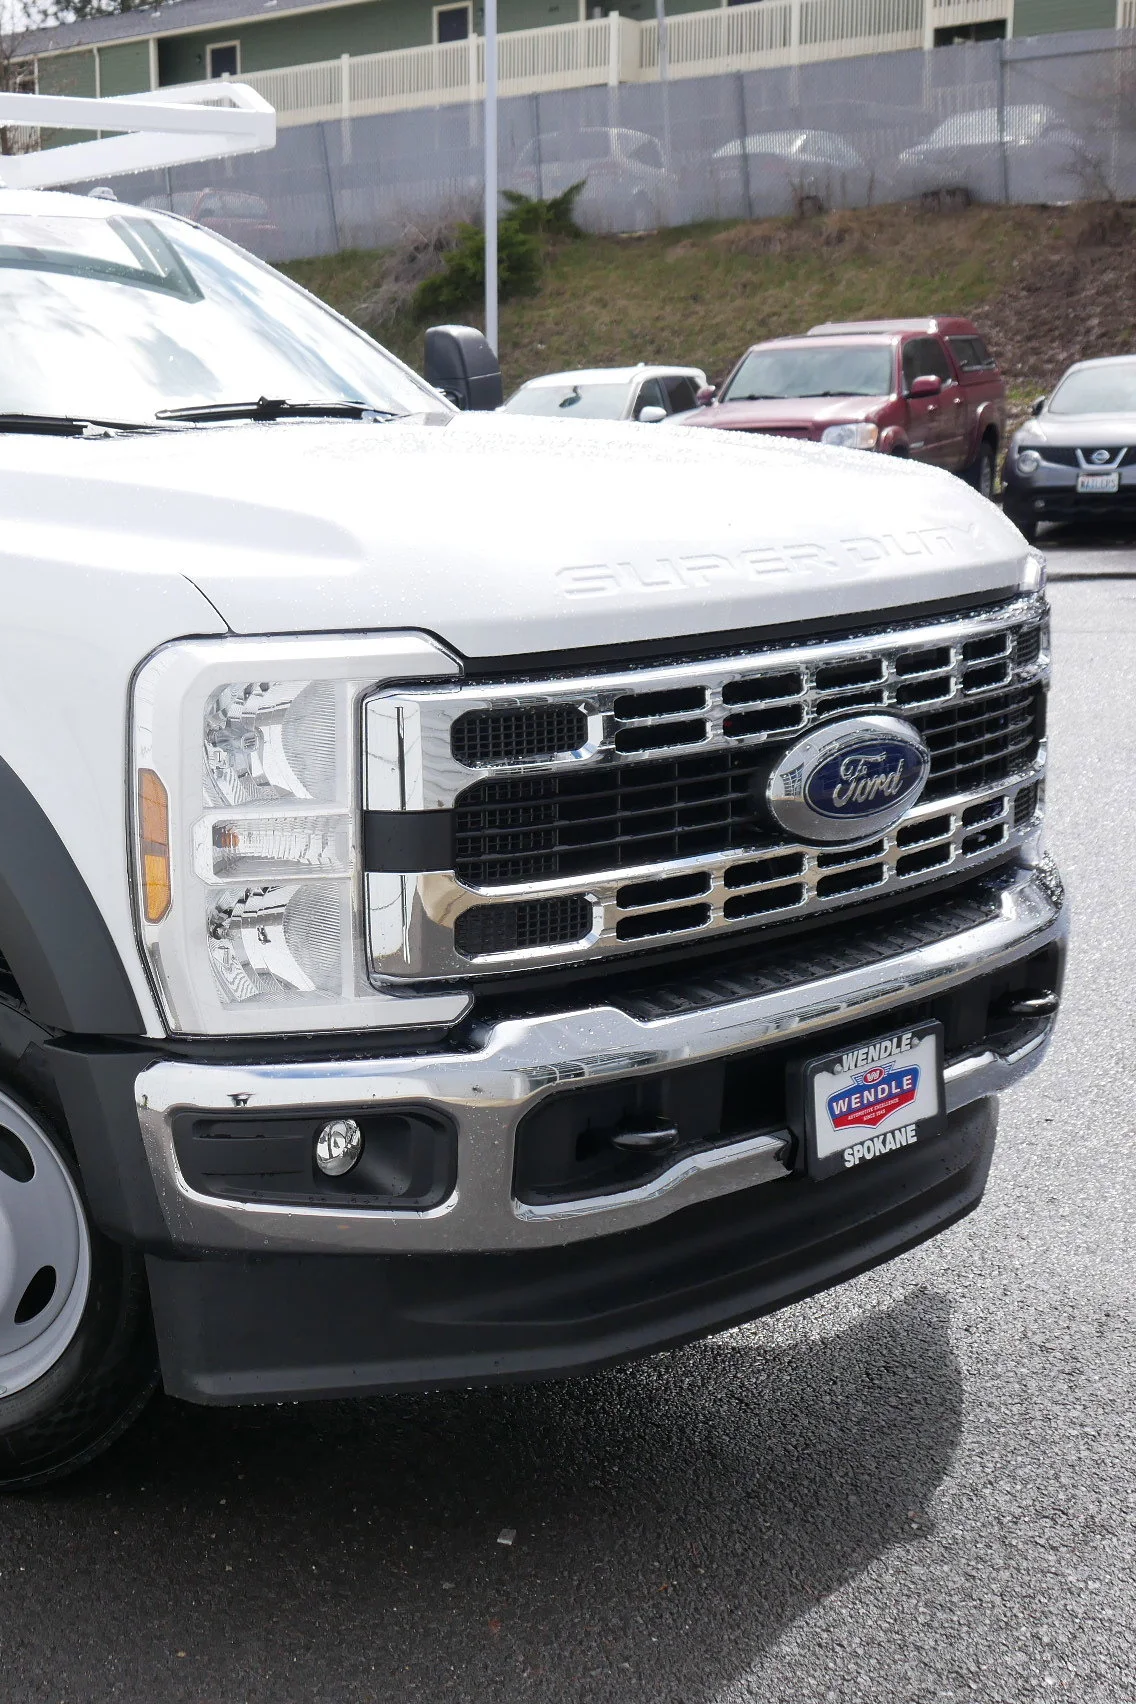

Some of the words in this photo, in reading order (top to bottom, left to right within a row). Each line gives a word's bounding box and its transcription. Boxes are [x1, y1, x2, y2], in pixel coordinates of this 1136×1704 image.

[555, 541, 838, 600] SUPER
[840, 522, 990, 568] DUTY
[832, 751, 904, 808] Ford
[842, 1033, 912, 1071] WENDLE
[832, 1075, 912, 1115] WENDLE
[847, 1106, 873, 1120] AUTOMOTIVE
[874, 1097, 899, 1111] EXCELLENCE
[844, 1124, 917, 1168] SPOKANE
